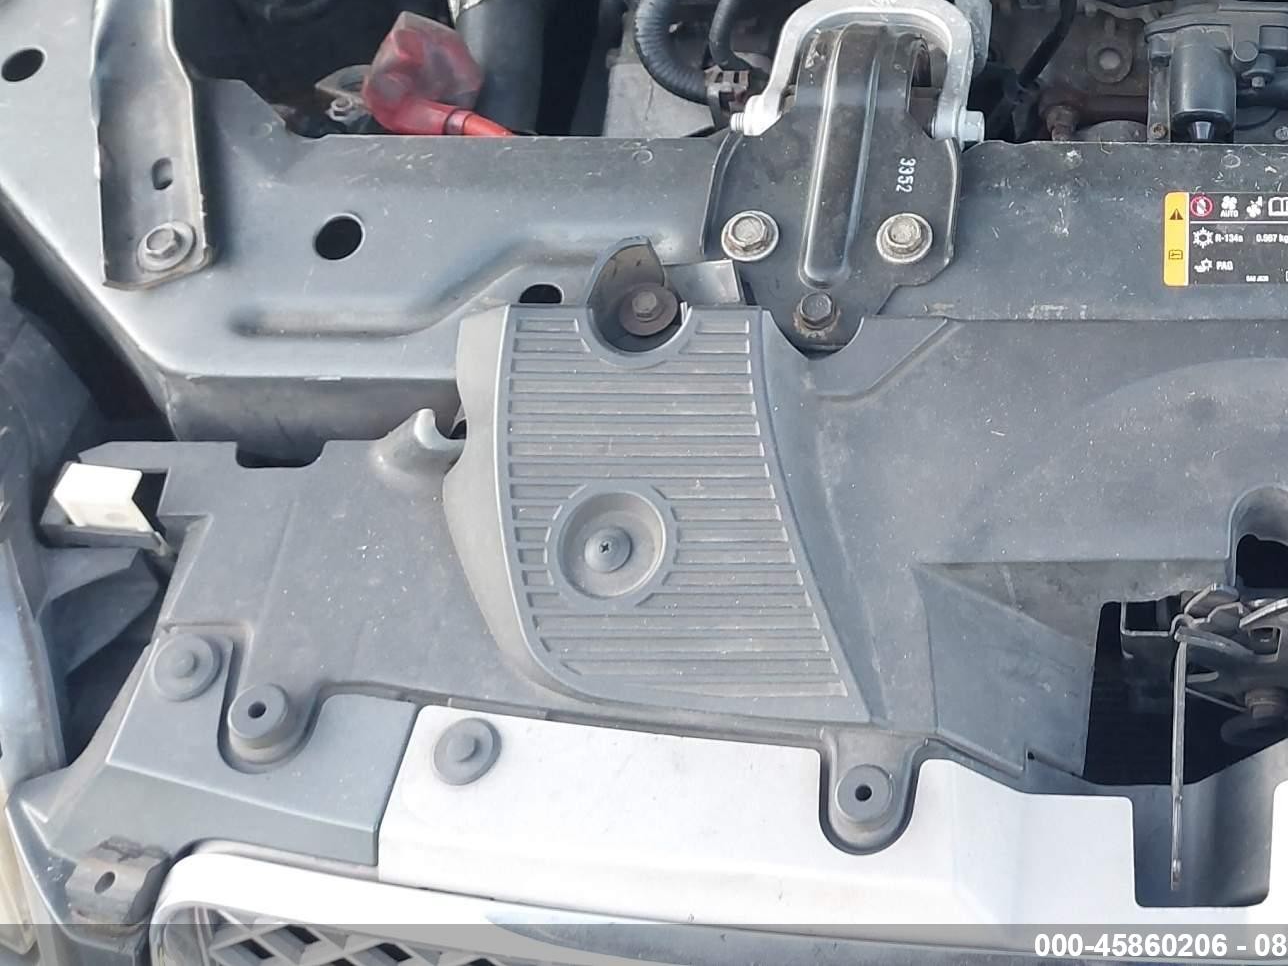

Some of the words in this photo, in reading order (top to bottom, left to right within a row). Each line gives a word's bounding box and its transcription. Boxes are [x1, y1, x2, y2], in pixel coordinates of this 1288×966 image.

[896, 158, 916, 192] 3352
[1220, 209, 1239, 218] AUTO
[1215, 234, 1243, 242] R-134a
[1216, 261, 1234, 270] PAG
